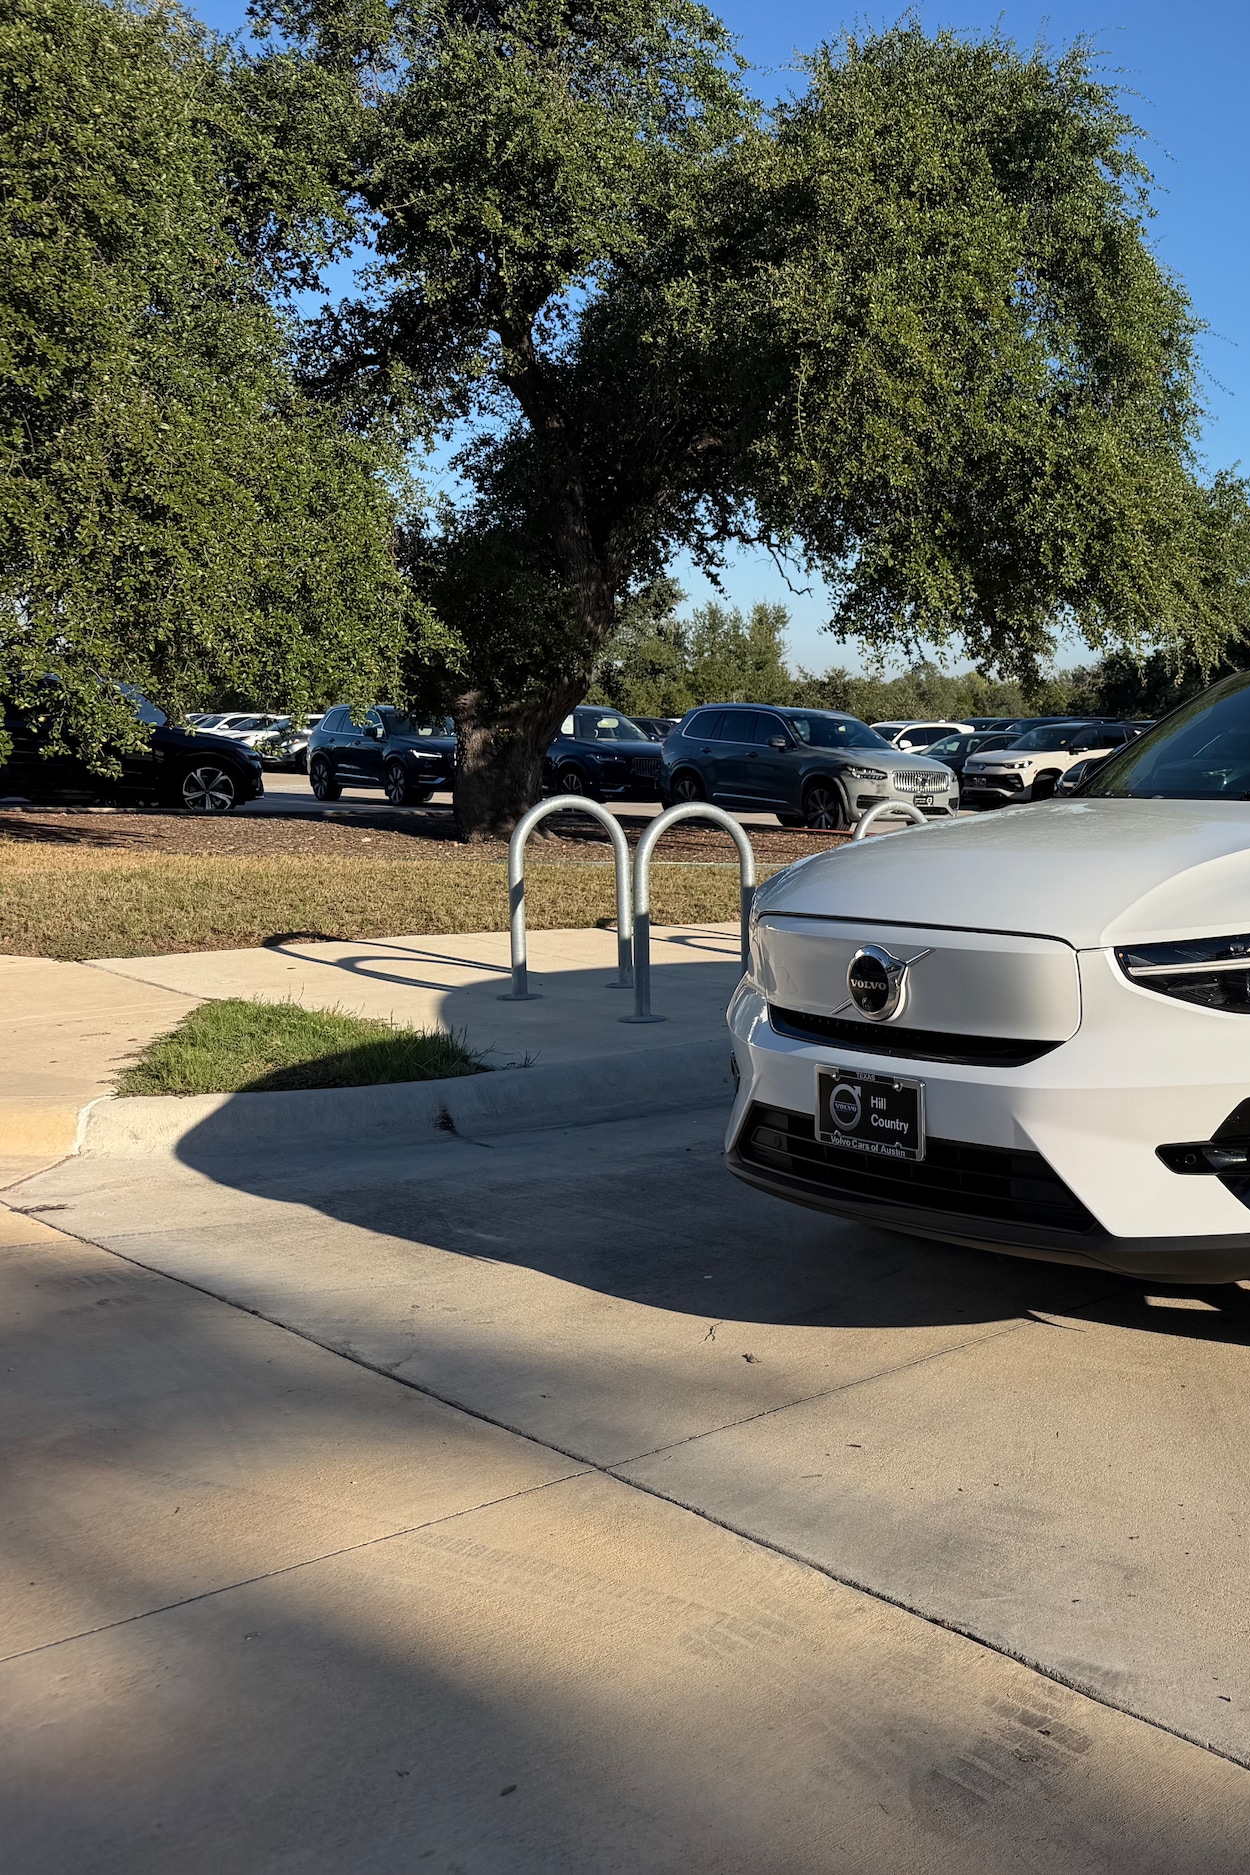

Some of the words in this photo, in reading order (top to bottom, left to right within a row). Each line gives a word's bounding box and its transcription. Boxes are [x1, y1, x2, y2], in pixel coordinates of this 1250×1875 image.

[850, 978, 887, 991] VOLVO
[855, 1072, 876, 1081] TEXAS
[834, 1102, 858, 1112] VOLVO
[870, 1095, 887, 1110] Hill
[870, 1113, 909, 1134] Country
[831, 1134, 851, 1147] Volvo
[852, 1139, 870, 1150] Cars
[871, 1144, 879, 1152] of
[881, 1146, 906, 1158] Austin
